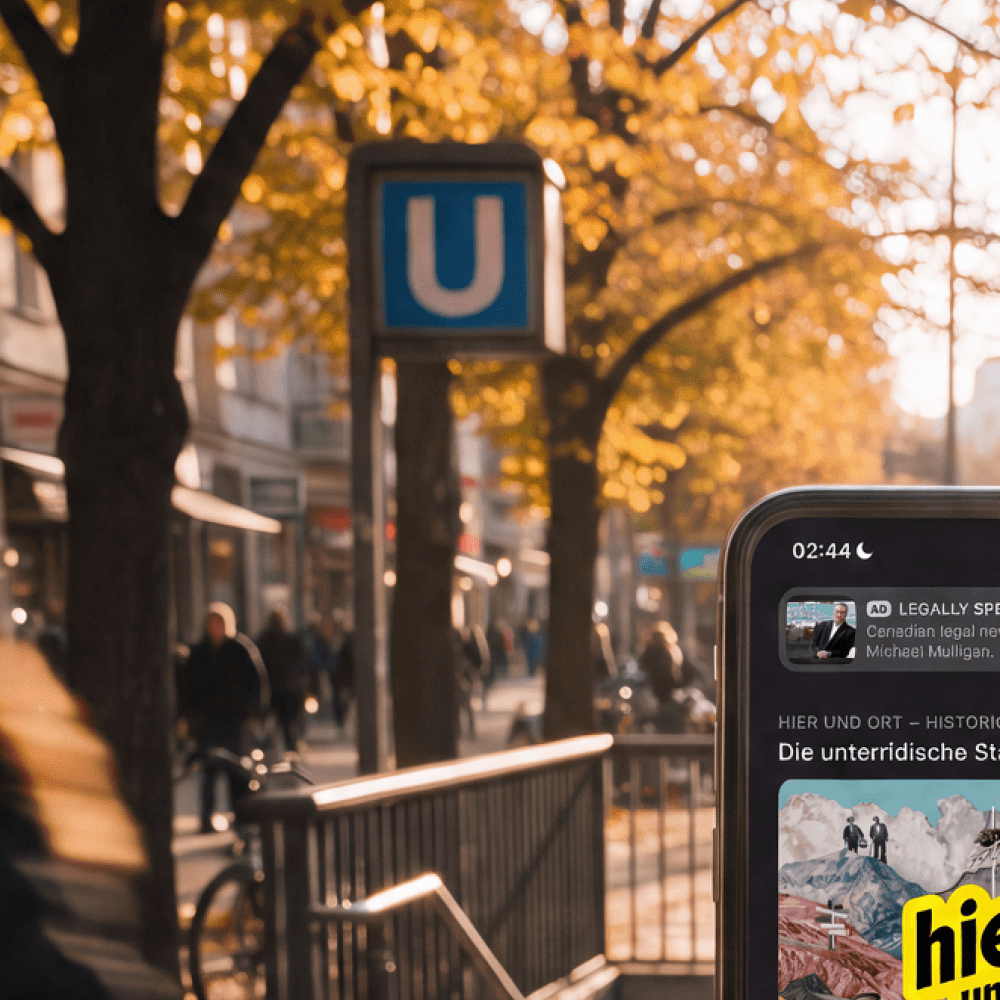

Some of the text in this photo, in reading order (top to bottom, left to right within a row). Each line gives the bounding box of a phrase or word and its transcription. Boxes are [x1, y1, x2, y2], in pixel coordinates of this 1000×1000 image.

[406, 195, 505, 318] U
[792, 541, 852, 560] 02:44
[870, 604, 888, 615] AD
[899, 601, 969, 616] LEGALLY
[940, 624, 975, 640] legal
[778, 715, 818, 730] HIER
[824, 715, 862, 730] UND
[867, 715, 903, 730] ORT
[778, 741, 814, 762] Die
[821, 741, 968, 762] unterridische
